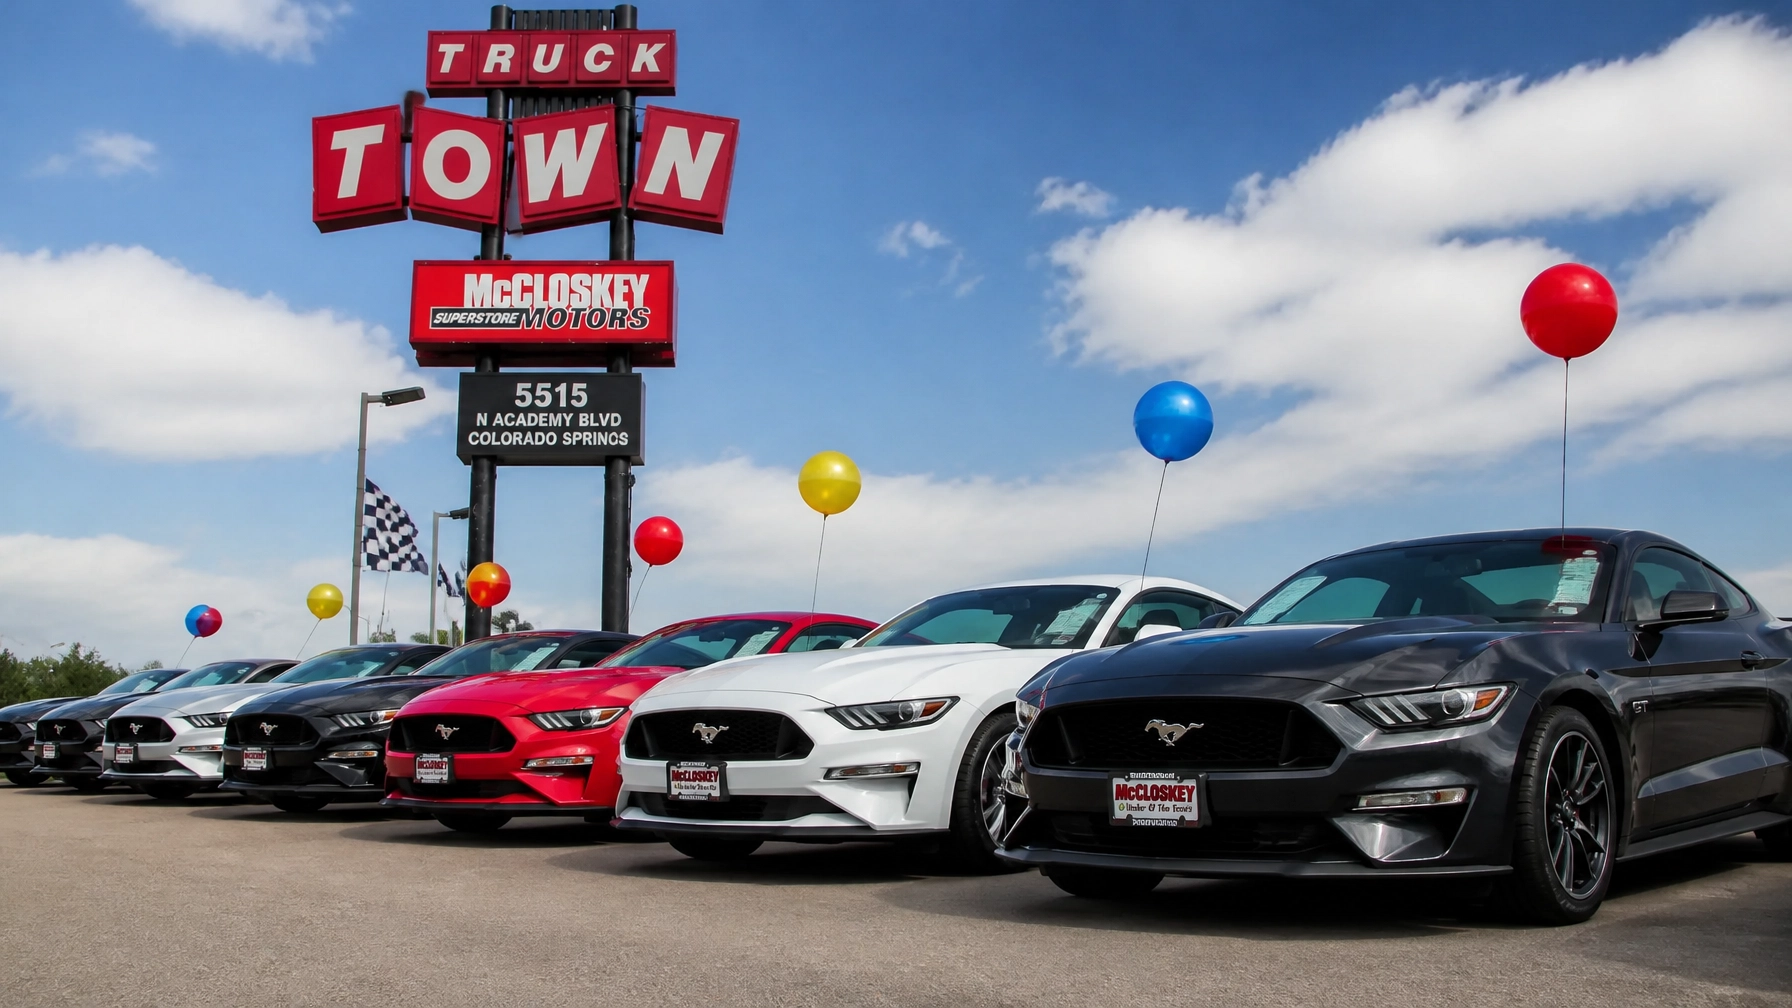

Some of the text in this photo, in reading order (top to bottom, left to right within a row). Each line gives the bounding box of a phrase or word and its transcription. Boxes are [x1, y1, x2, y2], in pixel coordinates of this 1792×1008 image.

[437, 42, 666, 74] TRUCK
[330, 122, 725, 203] TOWN
[463, 272, 650, 309] McCLOSKEY
[433, 306, 651, 330] SUPERSTORE MOTORS
[514, 382, 588, 408] 5515
[476, 412, 622, 427] N ACADEMY BLVD
[468, 430, 629, 446] COLORADO SPRINGS
[1115, 783, 1196, 803] McCLOSKEY
